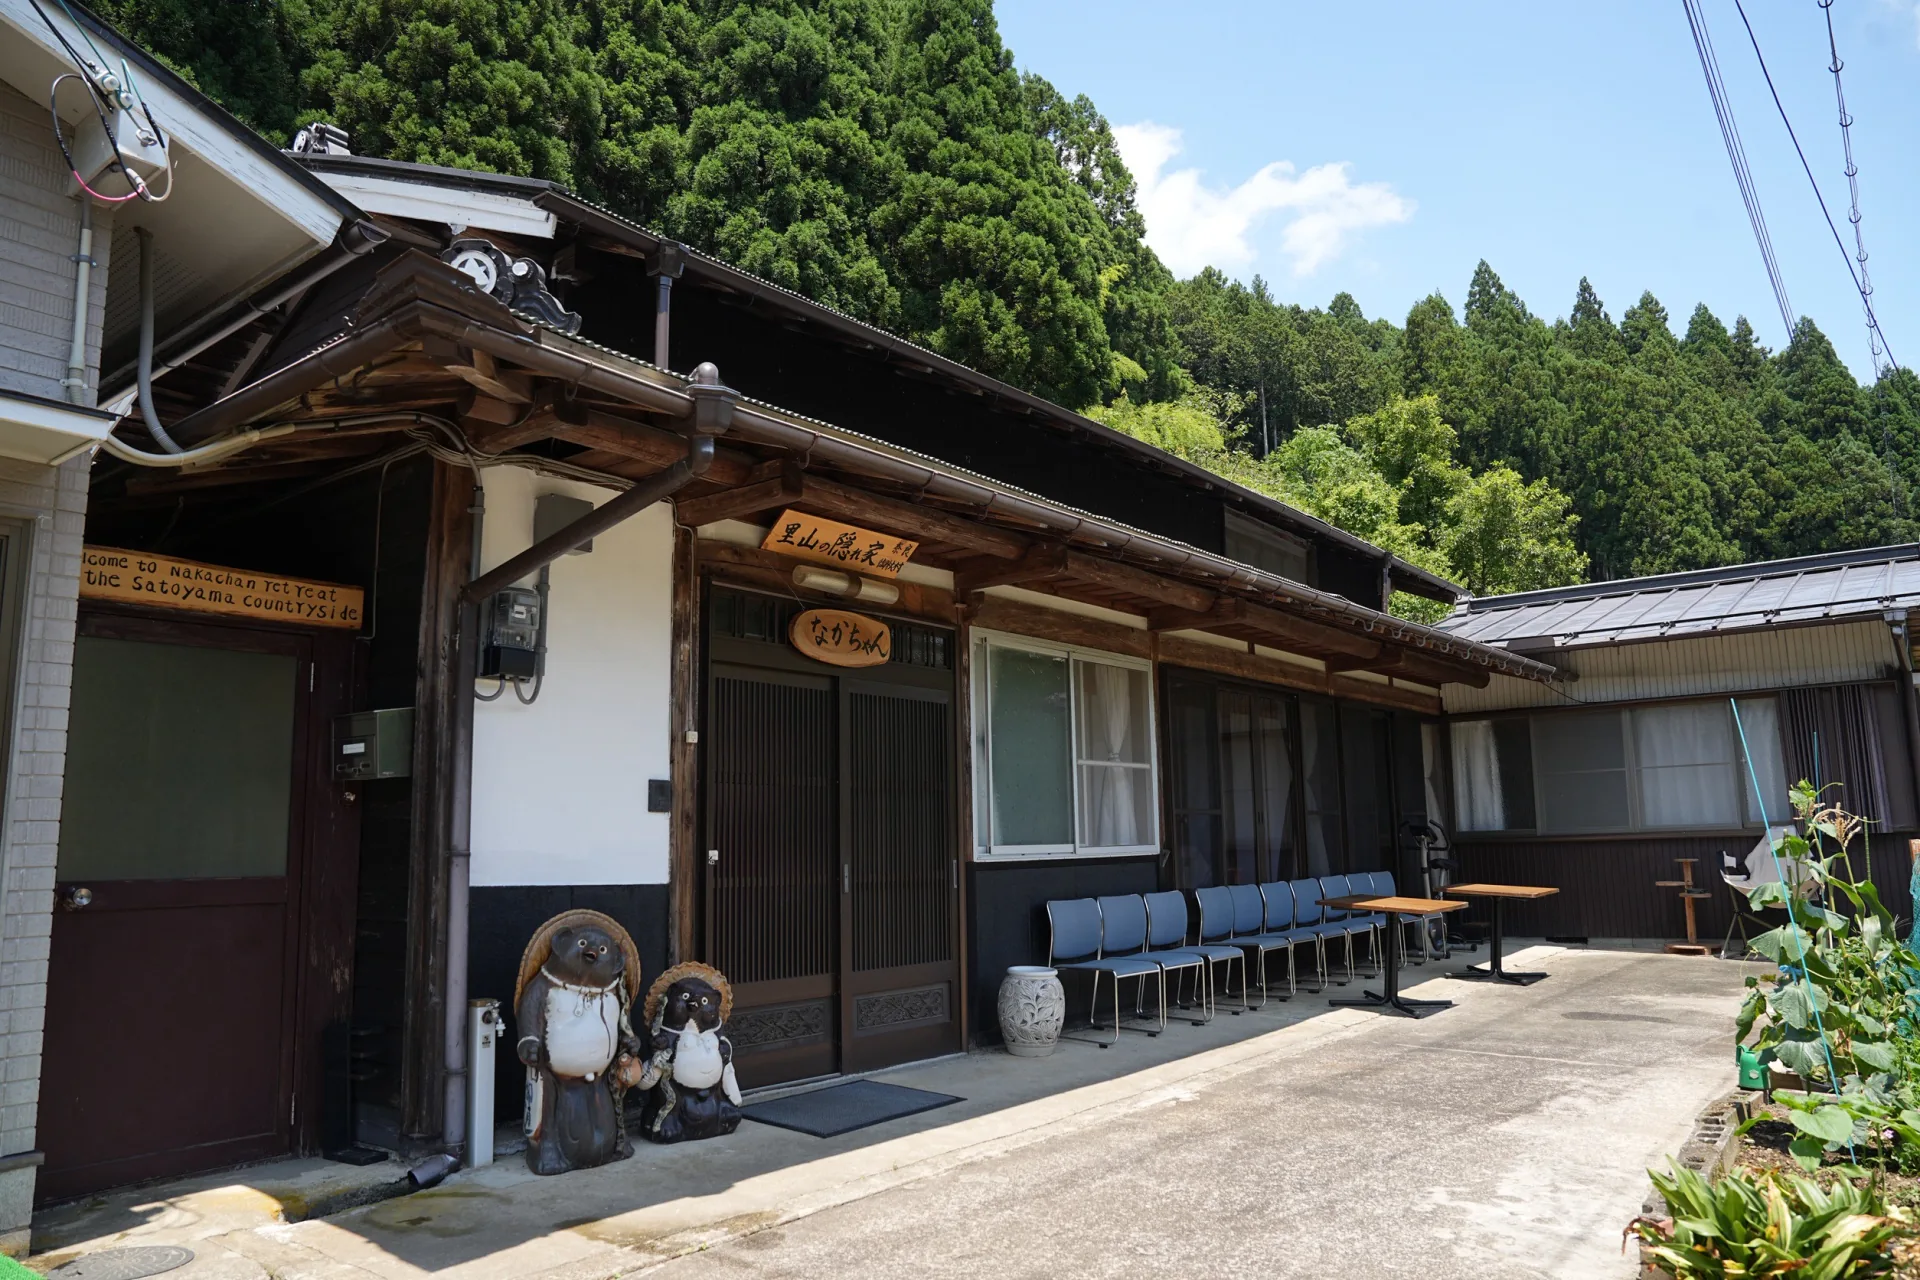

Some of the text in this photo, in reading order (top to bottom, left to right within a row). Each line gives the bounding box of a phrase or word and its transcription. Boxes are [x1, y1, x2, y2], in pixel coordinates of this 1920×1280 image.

[776, 522, 885, 566] 里山の隠れ家
[891, 541, 913, 558] 奈良
[82, 552, 128, 569] lcome
[136, 560, 157, 574] to
[263, 580, 337, 602] retreat
[84, 569, 358, 620] the Satoyama countryside
[810, 615, 889, 658] なかちゃん
